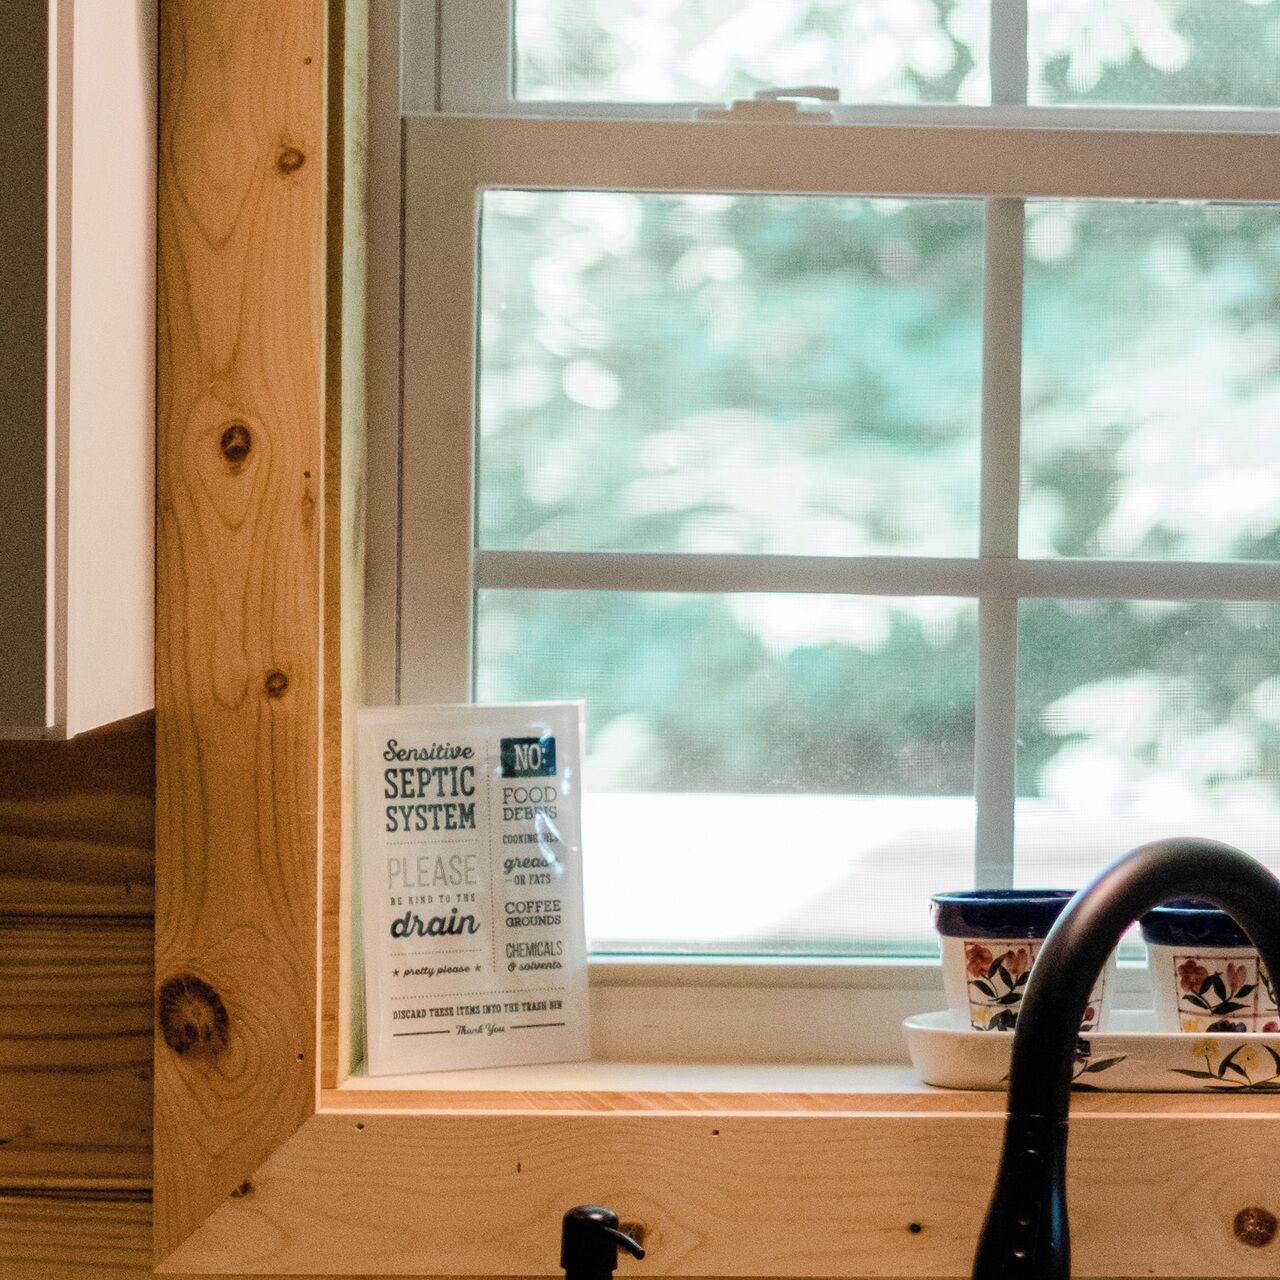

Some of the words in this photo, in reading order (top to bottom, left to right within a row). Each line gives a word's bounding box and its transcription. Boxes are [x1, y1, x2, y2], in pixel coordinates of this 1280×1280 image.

[383, 738, 475, 761] Sensitive
[384, 765, 475, 799] SEPTIC
[502, 786, 557, 804] FOOD
[385, 802, 476, 832] SYSTEM
[386, 854, 477, 888] PLEASE
[514, 875, 526, 885] OR
[529, 874, 551, 885] FATS
[390, 896, 402, 905] BE
[409, 895, 433, 905] KIND
[439, 894, 450, 903] TO
[456, 893, 476, 902] THE
[504, 900, 560, 914] COFFEE
[390, 907, 480, 938] drain
[505, 915, 561, 928] GROUNDS
[505, 940, 563, 959] CHEMICALS
[403, 966, 434, 978] pretty
[437, 965, 470, 976] please
[519, 961, 562, 971] solvents
[393, 1008, 427, 1020] DISCARD
[429, 1006, 454, 1017] THESE
[456, 1005, 480, 1016] ITEMS
[482, 1003, 501, 1014] INTO
[504, 1002, 519, 1013] THE
[521, 1001, 546, 1012] TRASH
[549, 1000, 563, 1010] BIN
[455, 1024, 483, 1035] Thank
[485, 1023, 505, 1036] You
